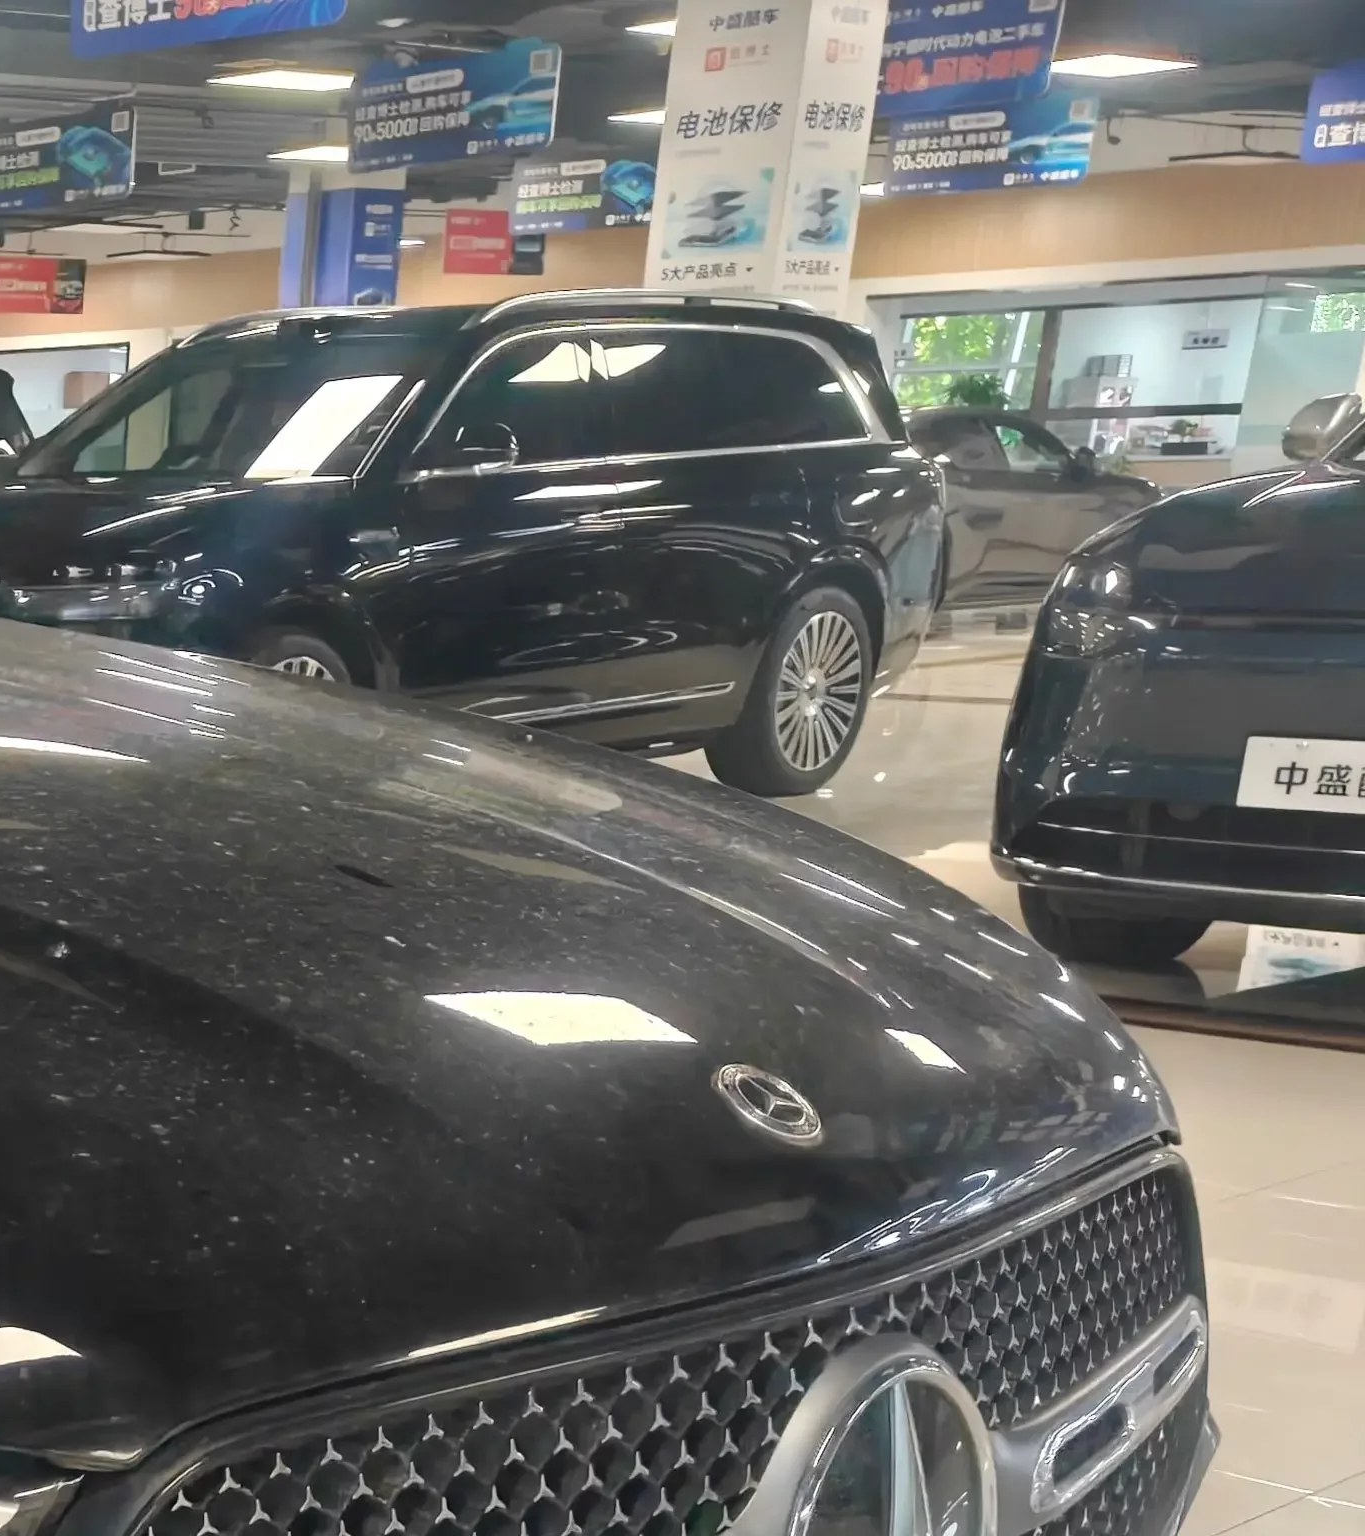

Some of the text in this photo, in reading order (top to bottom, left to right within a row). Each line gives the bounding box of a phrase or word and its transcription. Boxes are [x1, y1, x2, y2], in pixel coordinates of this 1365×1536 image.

[676, 100, 784, 139] 电池保修
[804, 100, 866, 132] 电池保修
[660, 262, 738, 281] 5大产品亮点
[1274, 761, 1365, 799] 中盛
